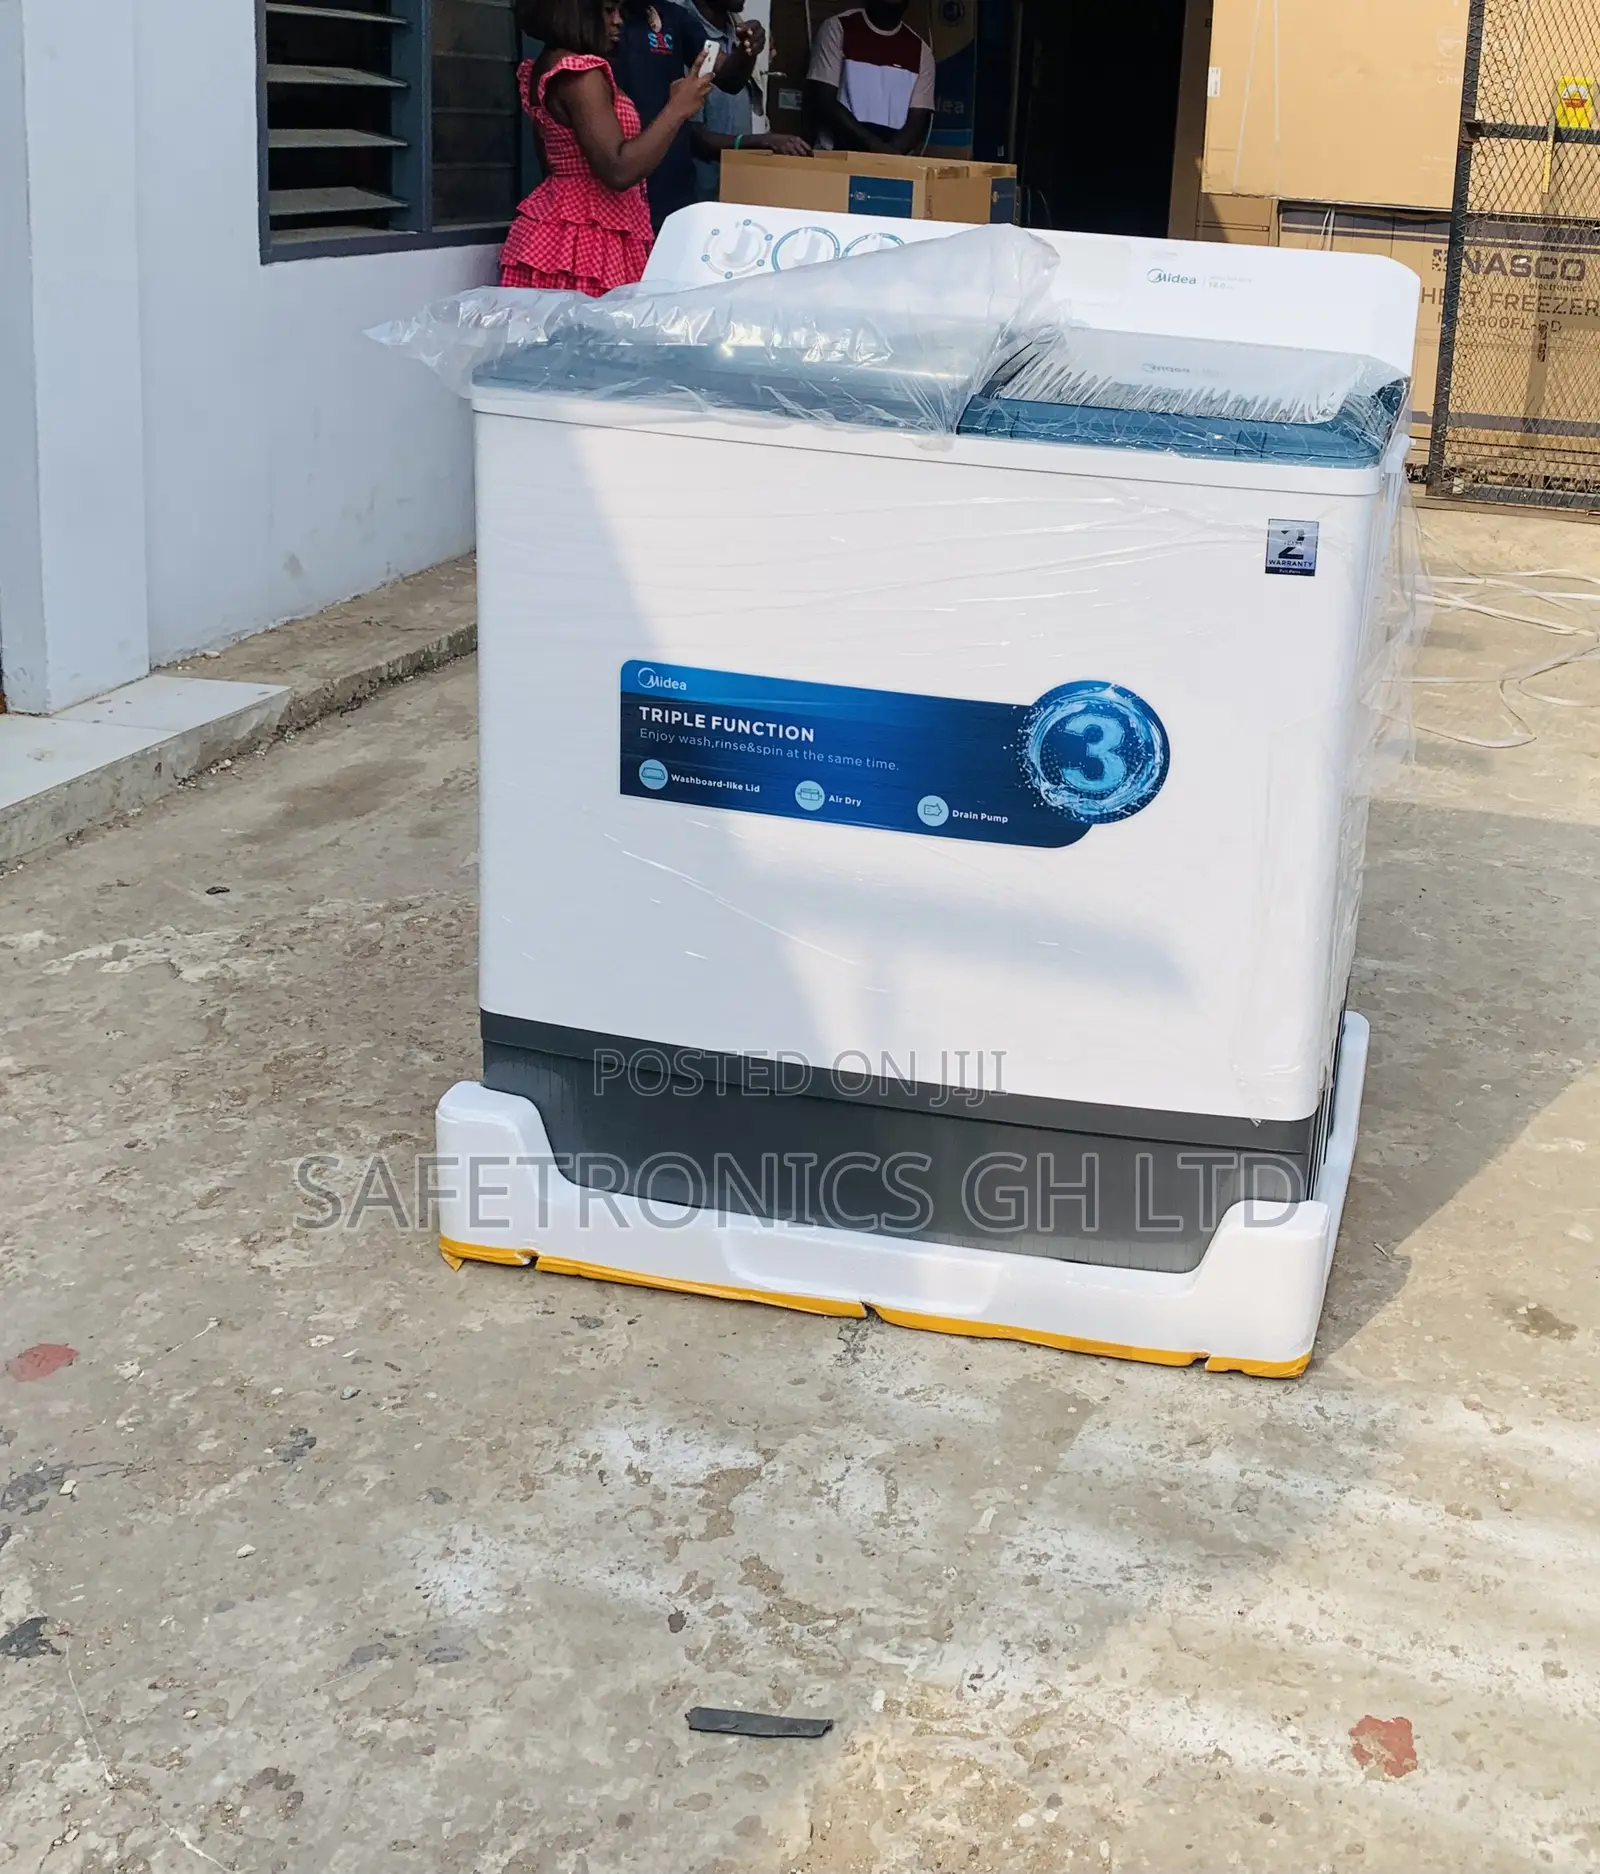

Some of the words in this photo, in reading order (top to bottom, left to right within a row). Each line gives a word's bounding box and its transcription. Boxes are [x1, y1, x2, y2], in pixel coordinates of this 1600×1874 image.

[1146, 268, 1197, 285] Midea
[1463, 250, 1586, 281] NASCO
[1488, 292, 1600, 317] FREEZER
[1268, 559, 1314, 568] WARRANTY
[637, 667, 687, 691] Midea
[639, 706, 706, 729] TRIPLE
[711, 716, 815, 743] FUNCTION
[640, 728, 675, 745] Enjoy
[679, 734, 783, 759] wash,rinse&spin
[786, 747, 799, 759] at
[803, 748, 824, 763] the
[828, 755, 863, 768] same
[866, 757, 900, 772] time.
[1058, 711, 1128, 791] 3
[671, 773, 744, 792] Washboard-like
[745, 783, 761, 793] Lid
[828, 794, 844, 805] Air
[845, 796, 862, 808] Dry
[952, 809, 978, 822] Drain
[980, 812, 1009, 825] Pump
